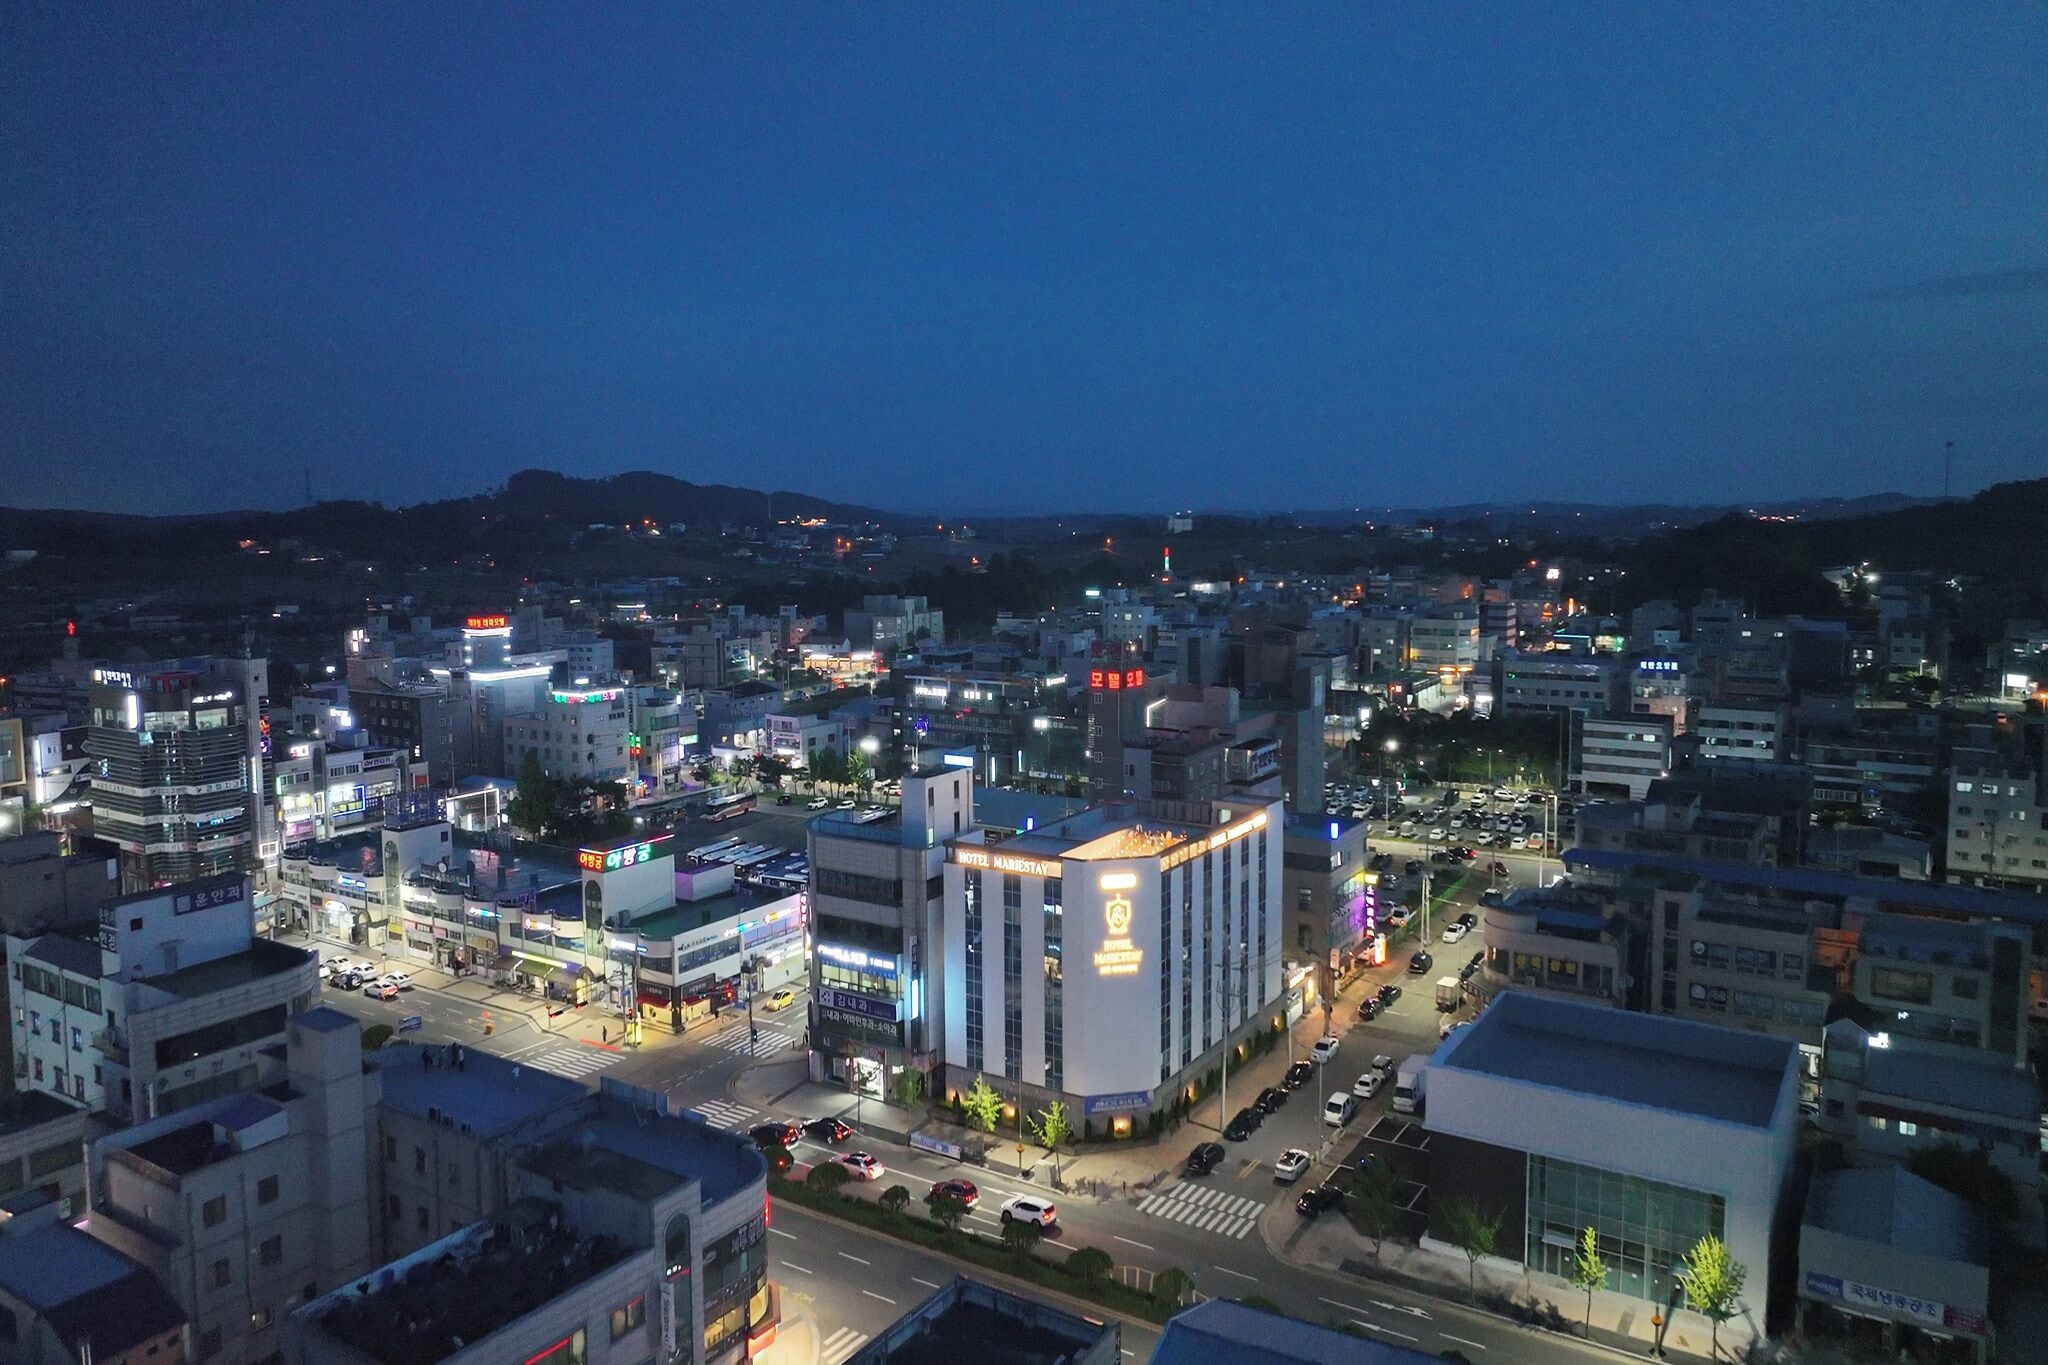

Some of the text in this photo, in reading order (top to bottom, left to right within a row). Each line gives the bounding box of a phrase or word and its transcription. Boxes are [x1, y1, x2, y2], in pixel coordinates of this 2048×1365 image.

[1091, 671, 1120, 689] 모텔
[579, 852, 602, 869] 아방궁
[606, 843, 652, 868] 아방궁
[959, 851, 1048, 875] HOTEL MARIESTAY
[837, 994, 868, 1013] 김내과
